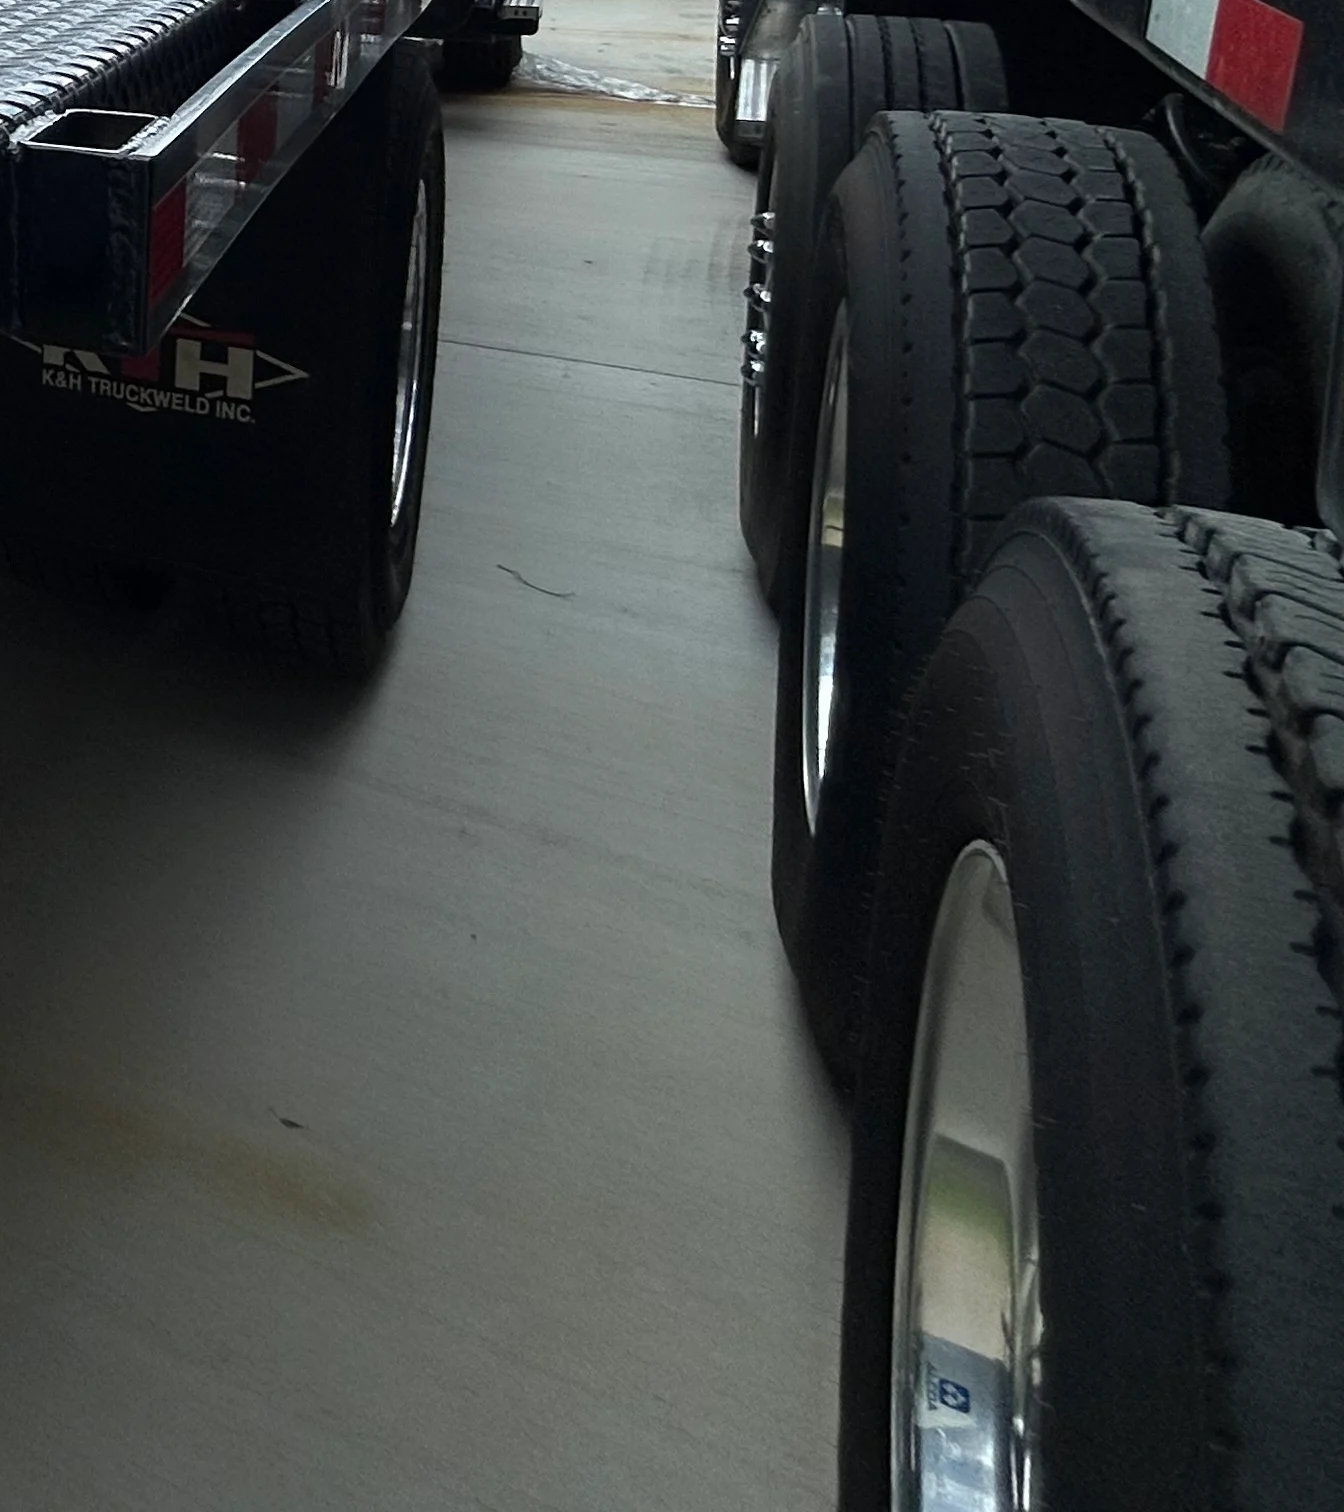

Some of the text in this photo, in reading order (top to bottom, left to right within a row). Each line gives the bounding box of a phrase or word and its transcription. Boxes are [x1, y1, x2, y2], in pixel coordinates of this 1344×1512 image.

[42, 369, 256, 425] K&H TRUCKWELD INC.
